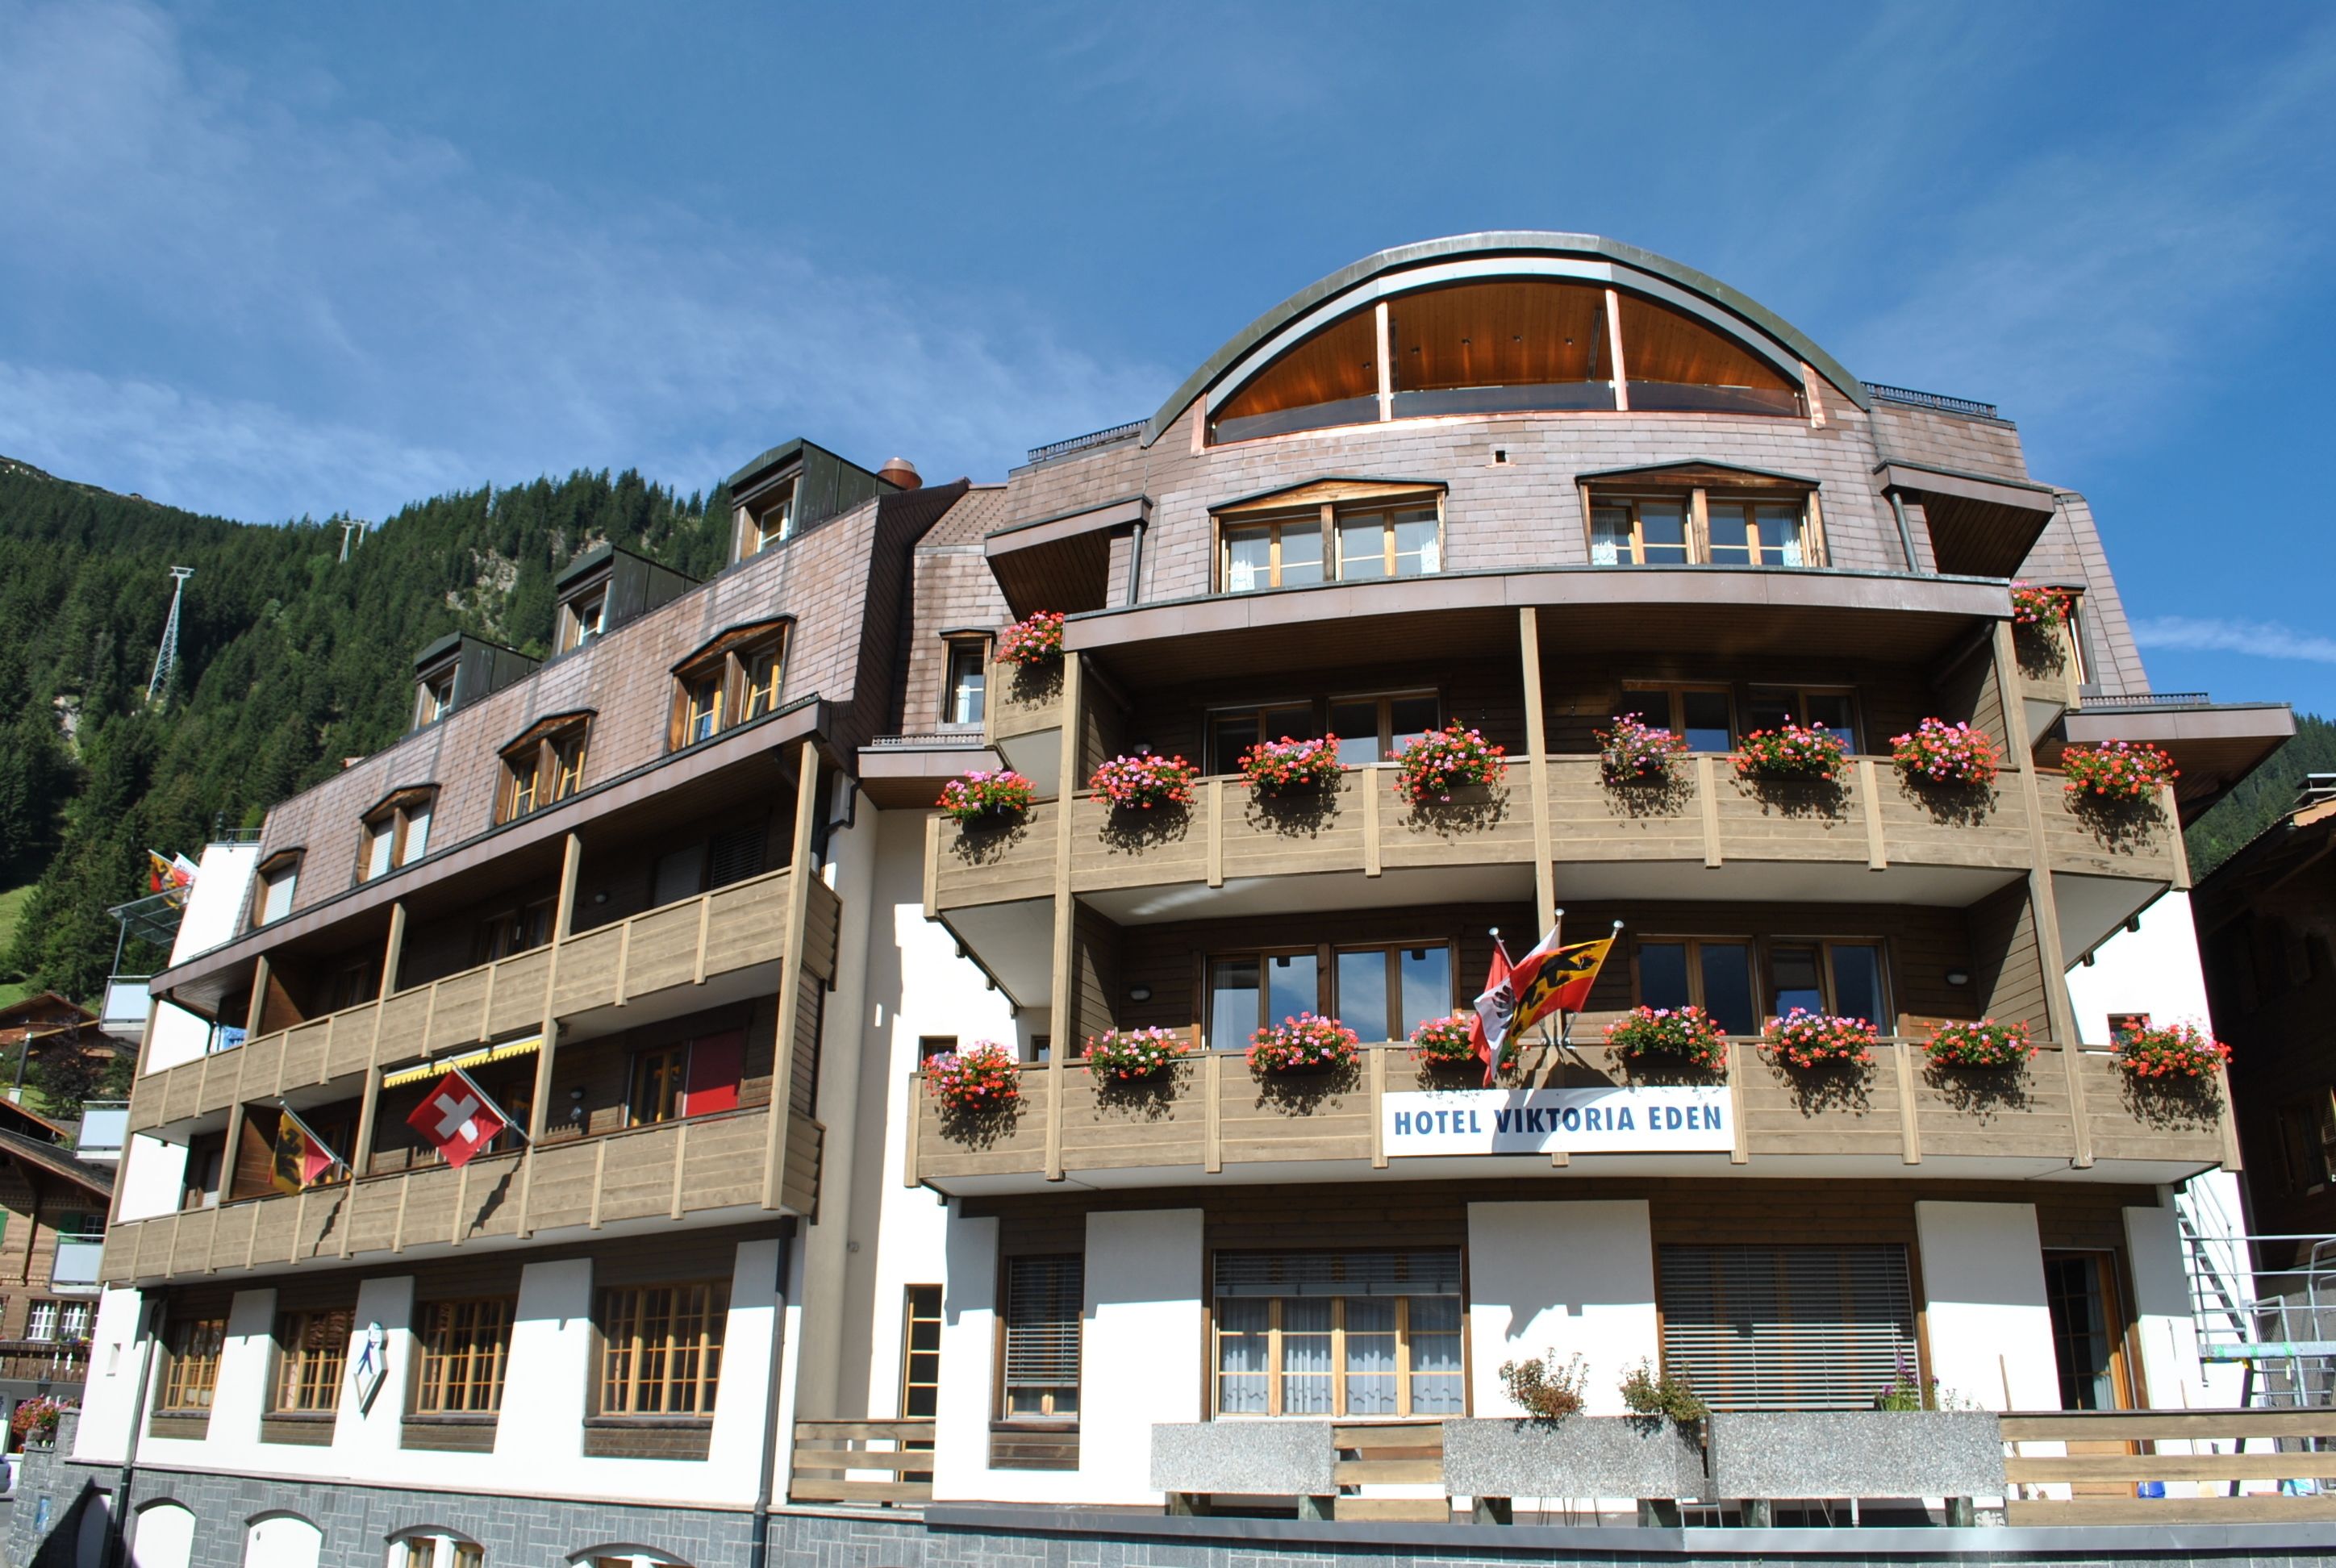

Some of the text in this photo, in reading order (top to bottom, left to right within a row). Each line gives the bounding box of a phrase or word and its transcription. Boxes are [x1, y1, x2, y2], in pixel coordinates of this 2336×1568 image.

[1395, 1106, 1722, 1135] HOTEL VIKTORIA EDEN
